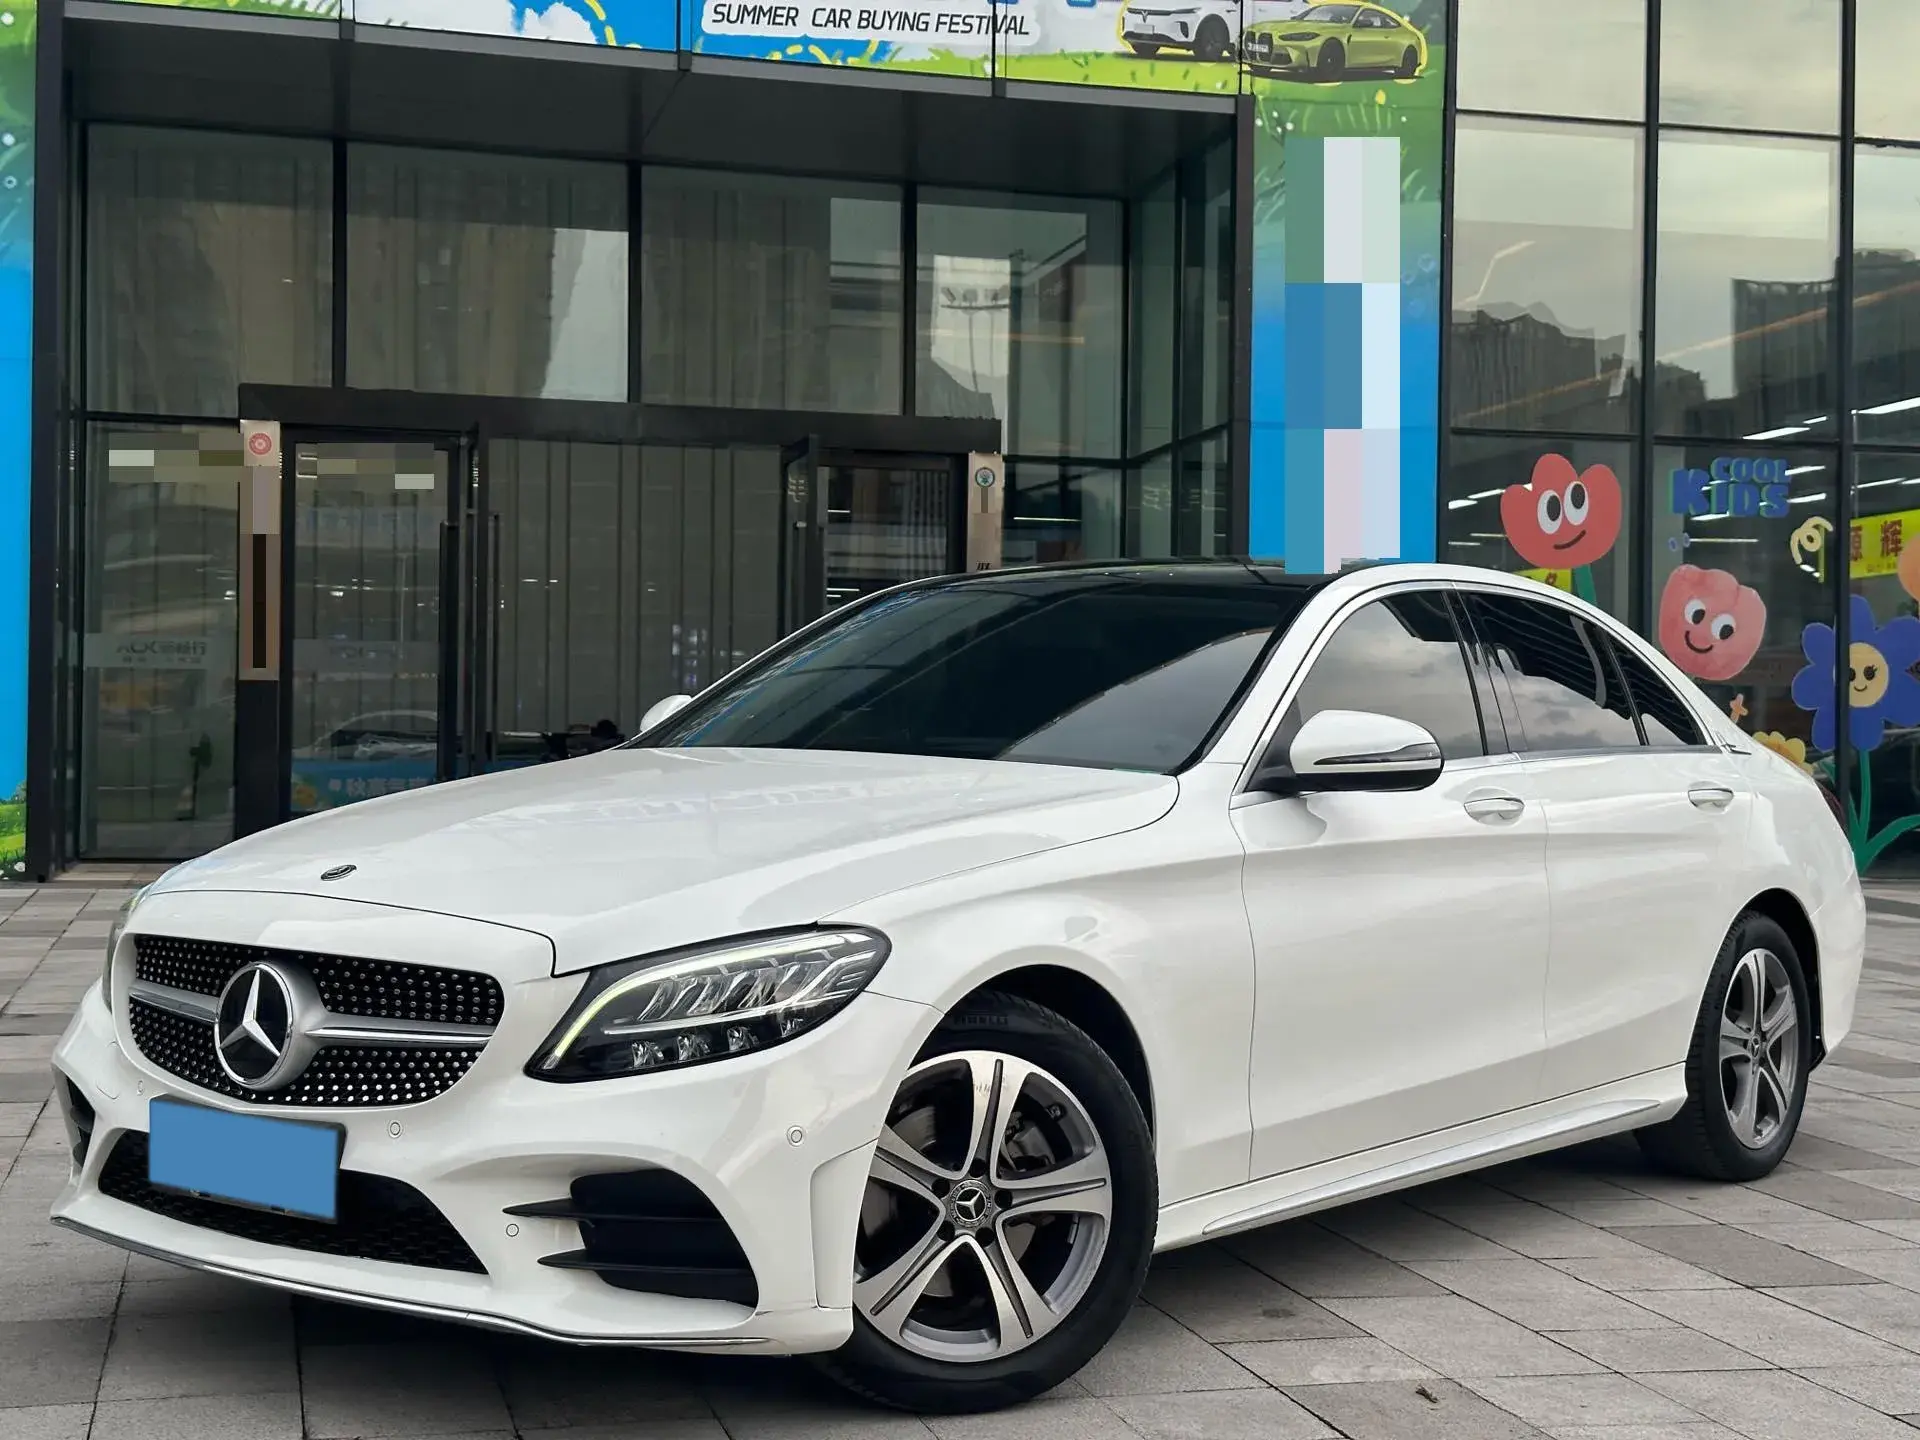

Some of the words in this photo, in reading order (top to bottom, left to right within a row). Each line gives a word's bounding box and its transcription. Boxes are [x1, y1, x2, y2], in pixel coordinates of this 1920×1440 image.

[712, 3, 799, 27] SUMMER
[811, 8, 852, 28] CAR
[857, 10, 930, 32] BUYING
[935, 13, 1029, 35] FESTIVAL
[1711, 457, 1788, 483] COOL
